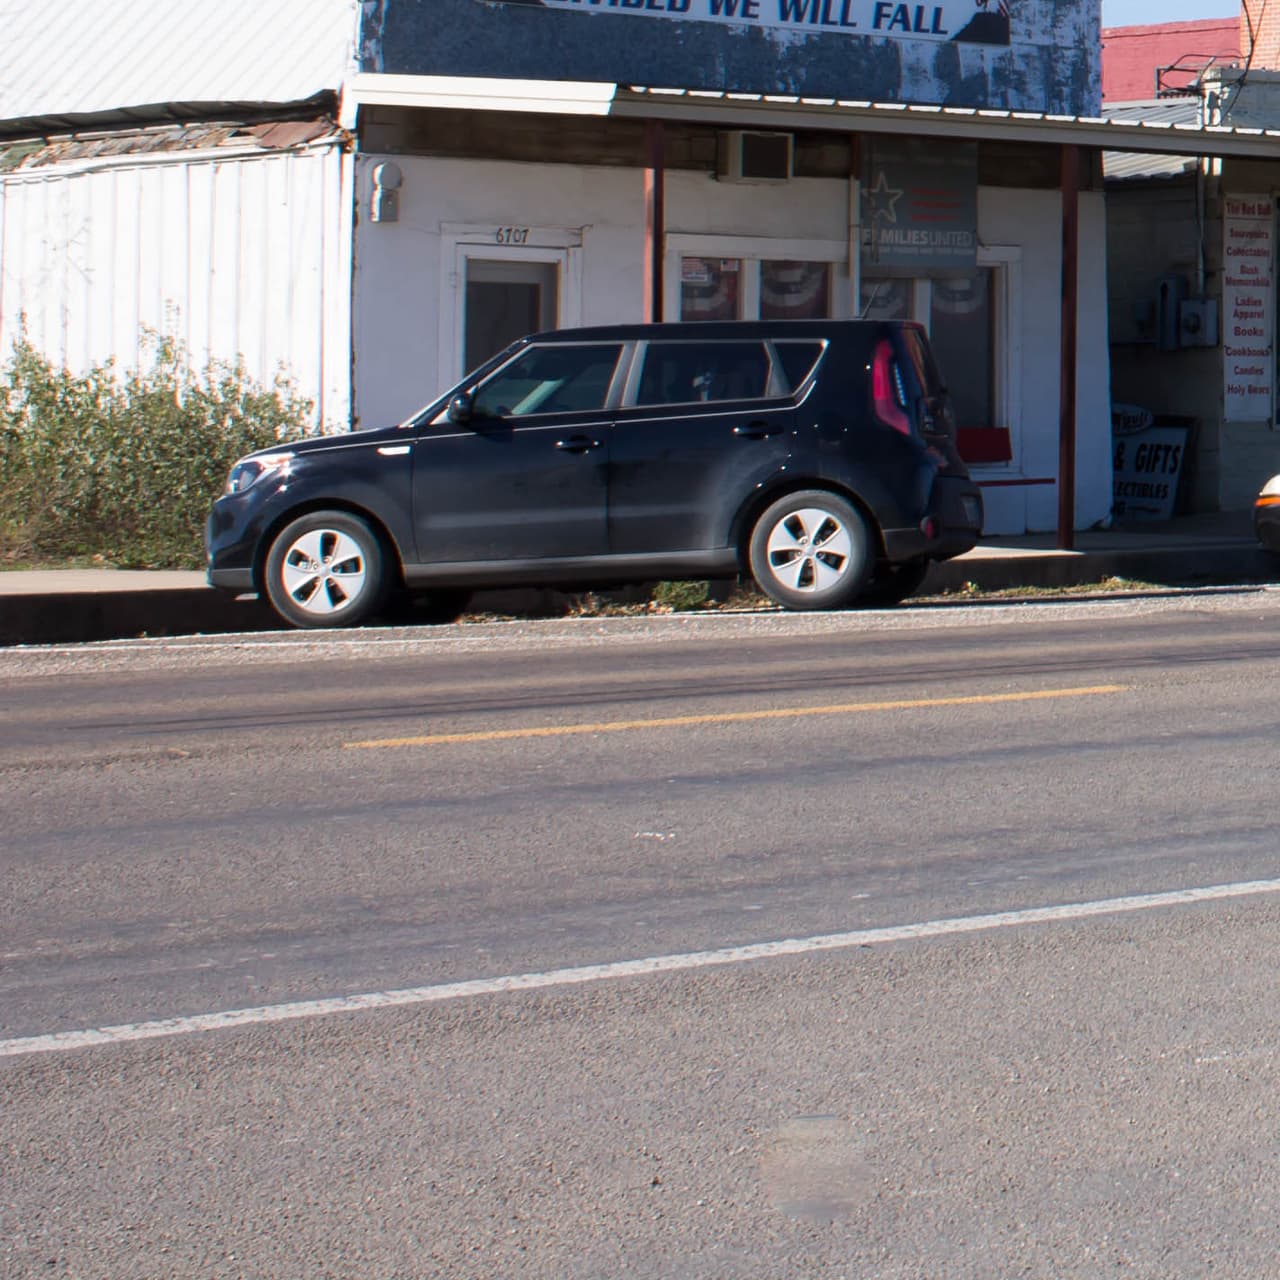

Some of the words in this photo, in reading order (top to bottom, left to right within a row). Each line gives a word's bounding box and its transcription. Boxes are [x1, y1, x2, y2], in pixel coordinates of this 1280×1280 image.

[872, 1, 949, 35] FALL
[495, 225, 529, 243] 6707
[1233, 325, 1265, 337] Books
[1135, 442, 1181, 475] GIFTS
